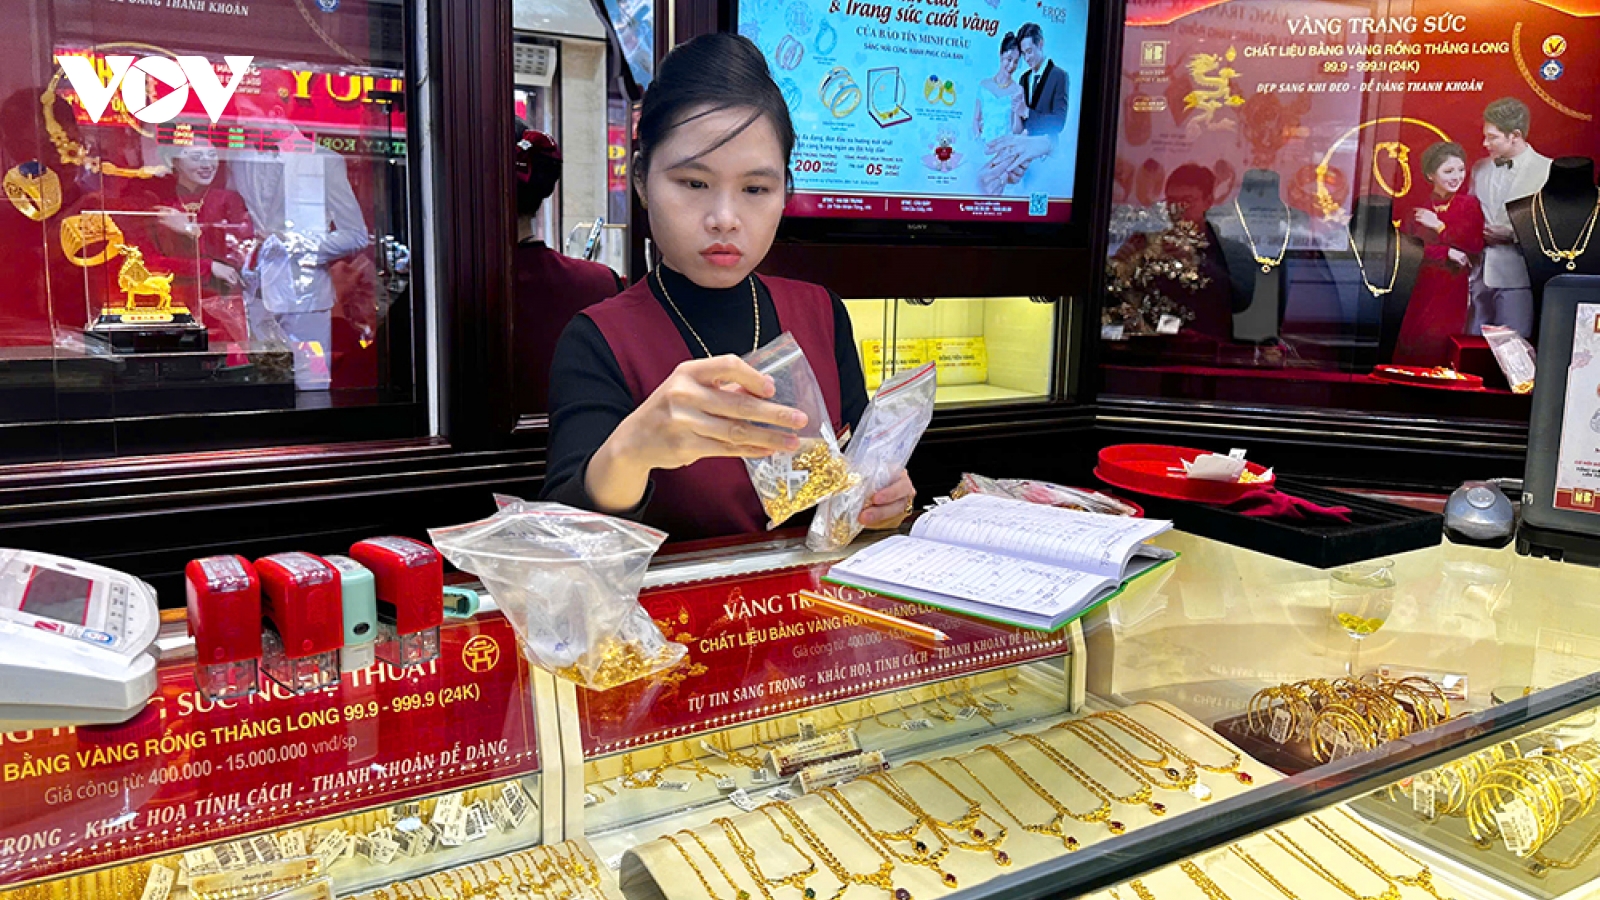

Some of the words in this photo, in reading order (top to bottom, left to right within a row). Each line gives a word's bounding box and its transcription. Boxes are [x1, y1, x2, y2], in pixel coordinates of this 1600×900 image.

[895, 5, 923, 24] sức
[926, 9, 960, 28] cưới
[963, 13, 1000, 37] vàng
[1287, 15, 1341, 35] VÀNG
[1348, 16, 1418, 34] TRANG
[1423, 12, 1467, 33] SỨC
[1244, 43, 1278, 58] CHẤT
[1279, 45, 1306, 59] LIỆU
[1308, 41, 1344, 57] BẰNG
[1346, 42, 1381, 56] VÀNG
[1384, 40, 1421, 55] RỒNG
[1424, 41, 1470, 55] THĂNG
[1472, 42, 1510, 54] LONG
[1324, 61, 1348, 73] 99.9
[1388, 60, 1420, 74] (24K)
[1279, 82, 1305, 92] SANG
[1307, 82, 1327, 92] KHI
[1407, 81, 1443, 92] THANH
[794, 159, 822, 173] 200
[866, 162, 883, 176] 05
[723, 595, 783, 621] VÀNG
[700, 630, 736, 653] CHẤT
[738, 628, 766, 647] LIỆU
[769, 621, 805, 641] BẰNG
[806, 616, 841, 633] VÀNG
[688, 694, 705, 714] TỰ
[709, 690, 729, 707] TIN
[733, 683, 764, 702] SANG
[767, 674, 806, 695] TRỌNG
[817, 662, 846, 684] KHẮC
[875, 654, 900, 671] TÍNH
[902, 648, 928, 667] CÁCH
[4, 752, 70, 782] BẰNG
[76, 744, 140, 768] VÀNG
[145, 728, 207, 757] RỒNG
[211, 718, 281, 745] THĂNG
[286, 707, 340, 732] LONG
[343, 701, 379, 721] 99.9
[392, 692, 435, 713] 999.9
[439, 683, 480, 707] (24K)
[44, 786, 73, 806] Giá
[76, 780, 119, 799] công
[122, 772, 145, 790] từ:
[149, 759, 212, 785] 400.000
[226, 741, 308, 772] 15.000.000
[147, 804, 187, 827] HOẠ
[194, 789, 240, 817] TÍNH
[247, 781, 293, 807] CÁCH
[312, 767, 371, 793] THANH
[466, 739, 508, 761] DÀNG
